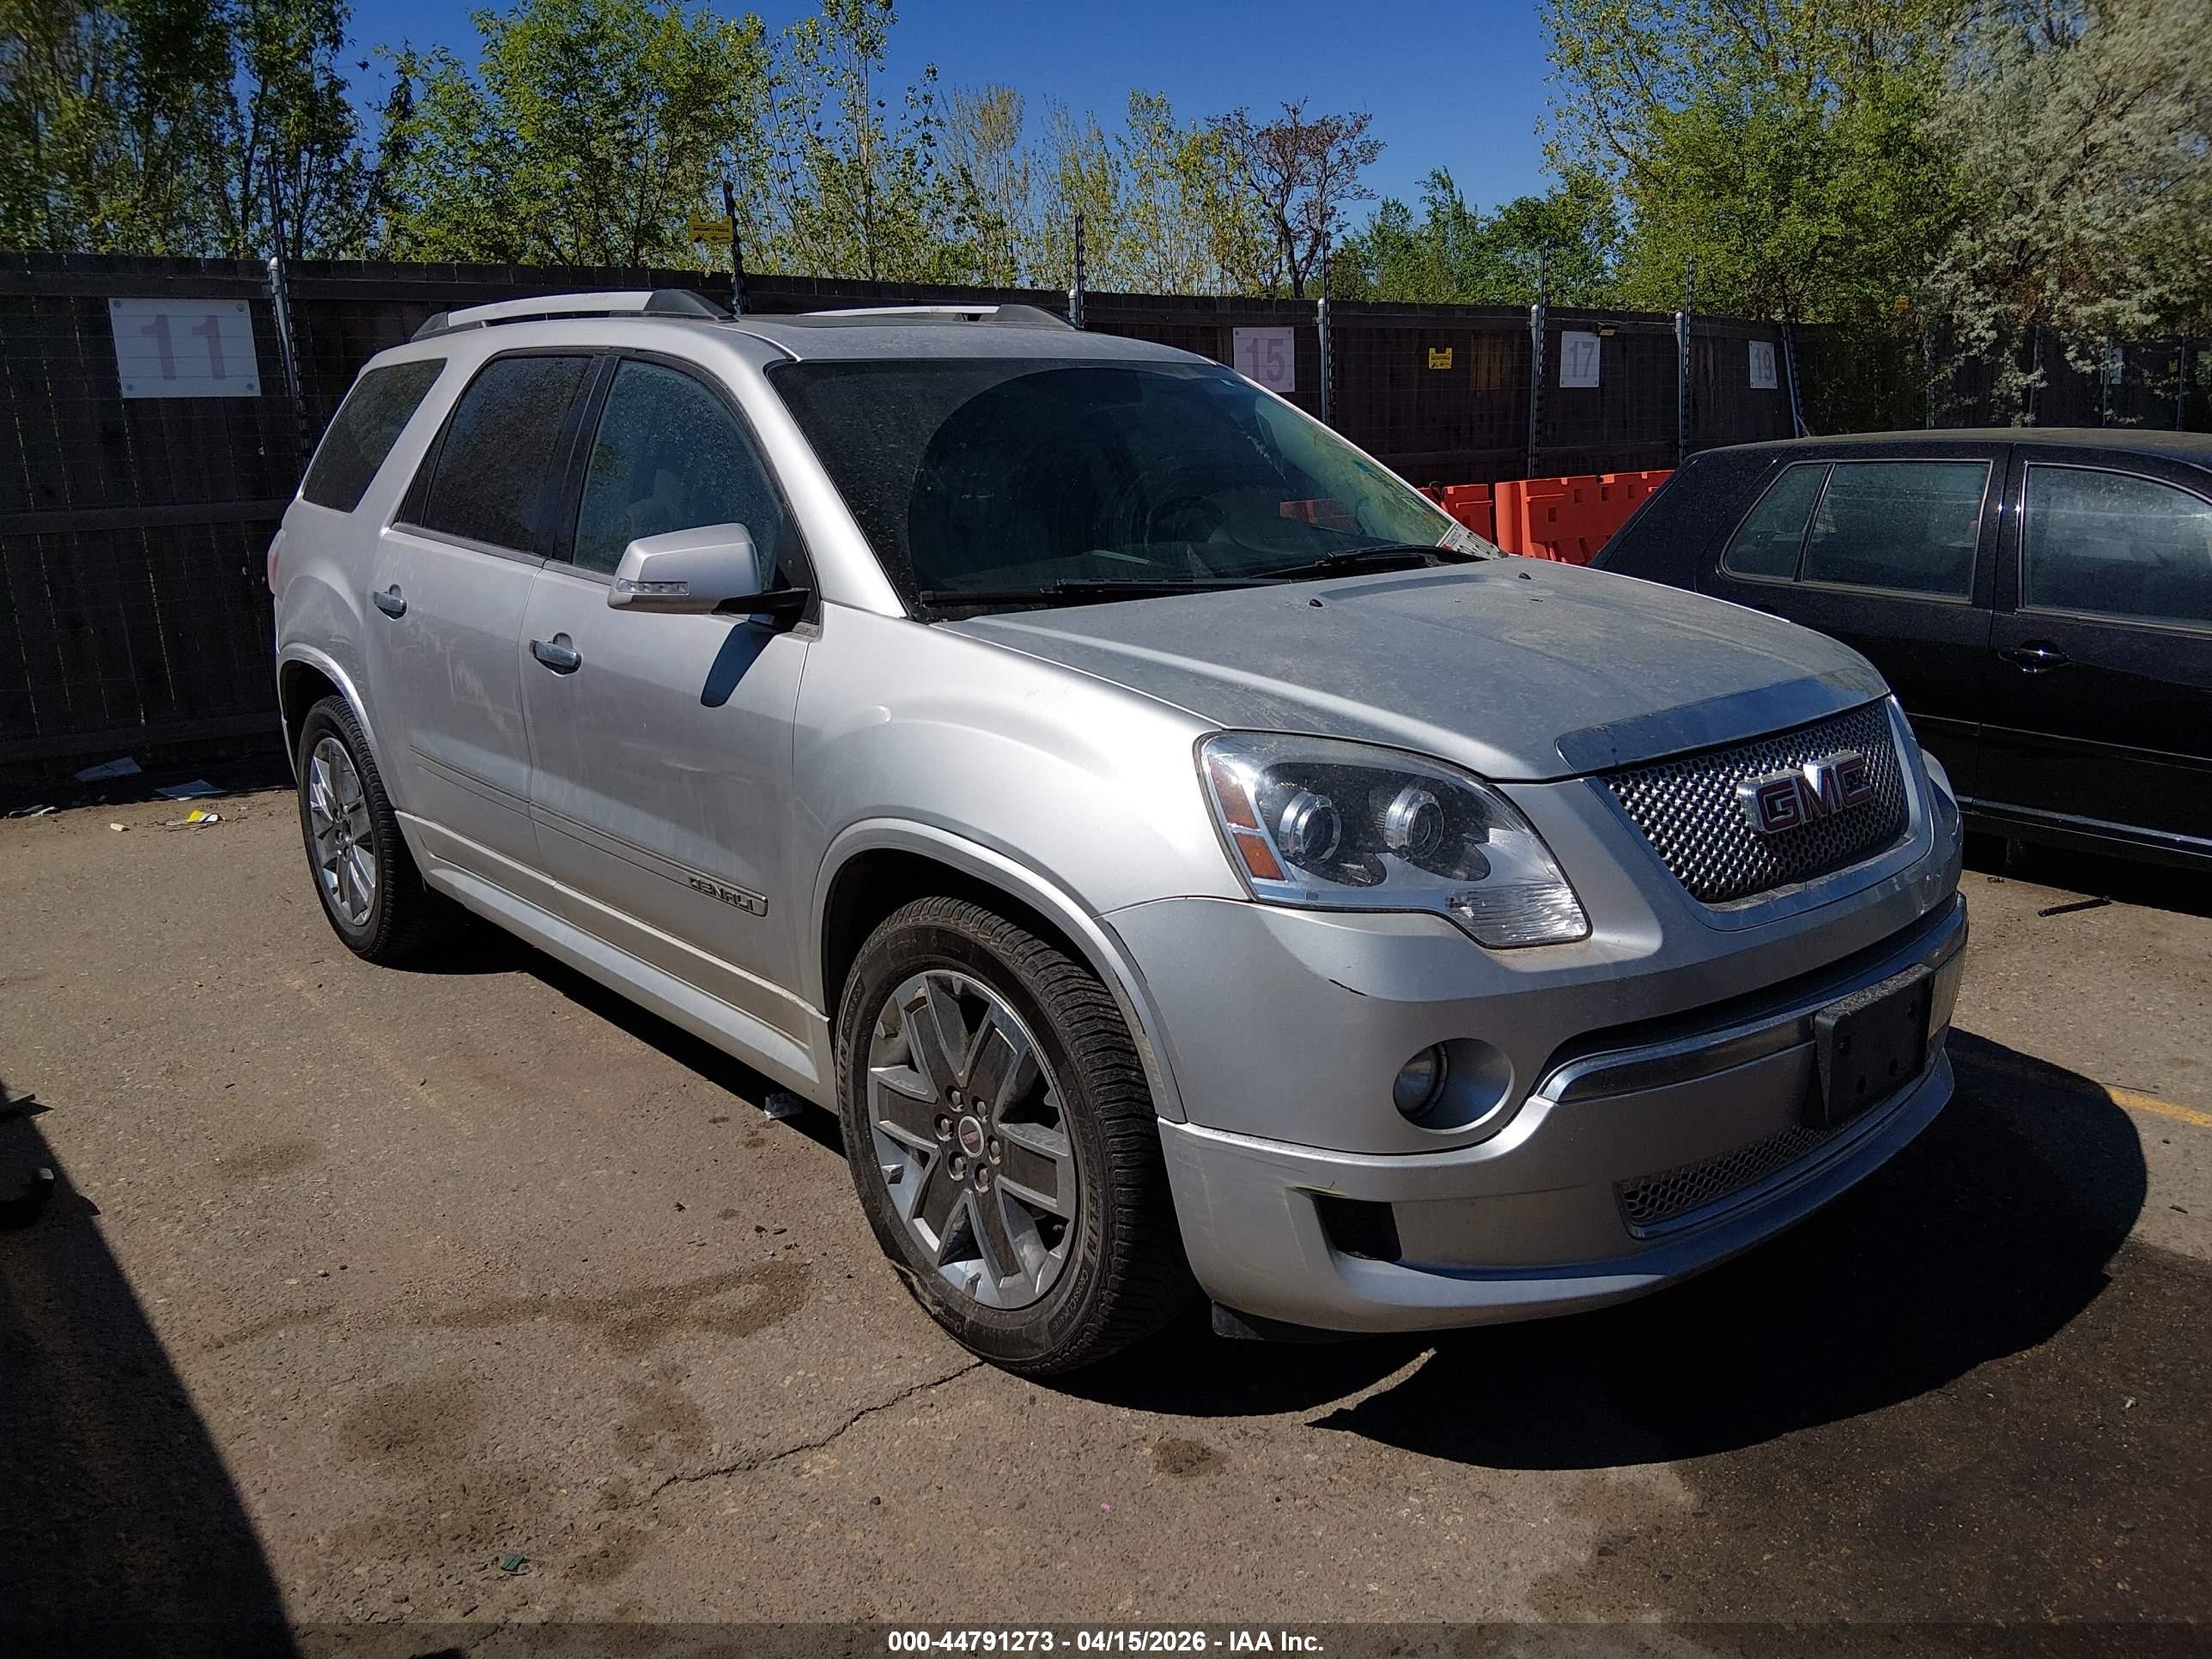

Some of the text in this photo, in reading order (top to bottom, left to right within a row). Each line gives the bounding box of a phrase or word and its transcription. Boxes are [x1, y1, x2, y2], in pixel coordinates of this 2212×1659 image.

[140, 314, 227, 381] 11
[1245, 337, 1285, 383] 15
[1569, 340, 1595, 379] 17
[1754, 348, 1773, 381] 19
[1753, 751, 1874, 834] GMC
[688, 877, 755, 911] DENALI
